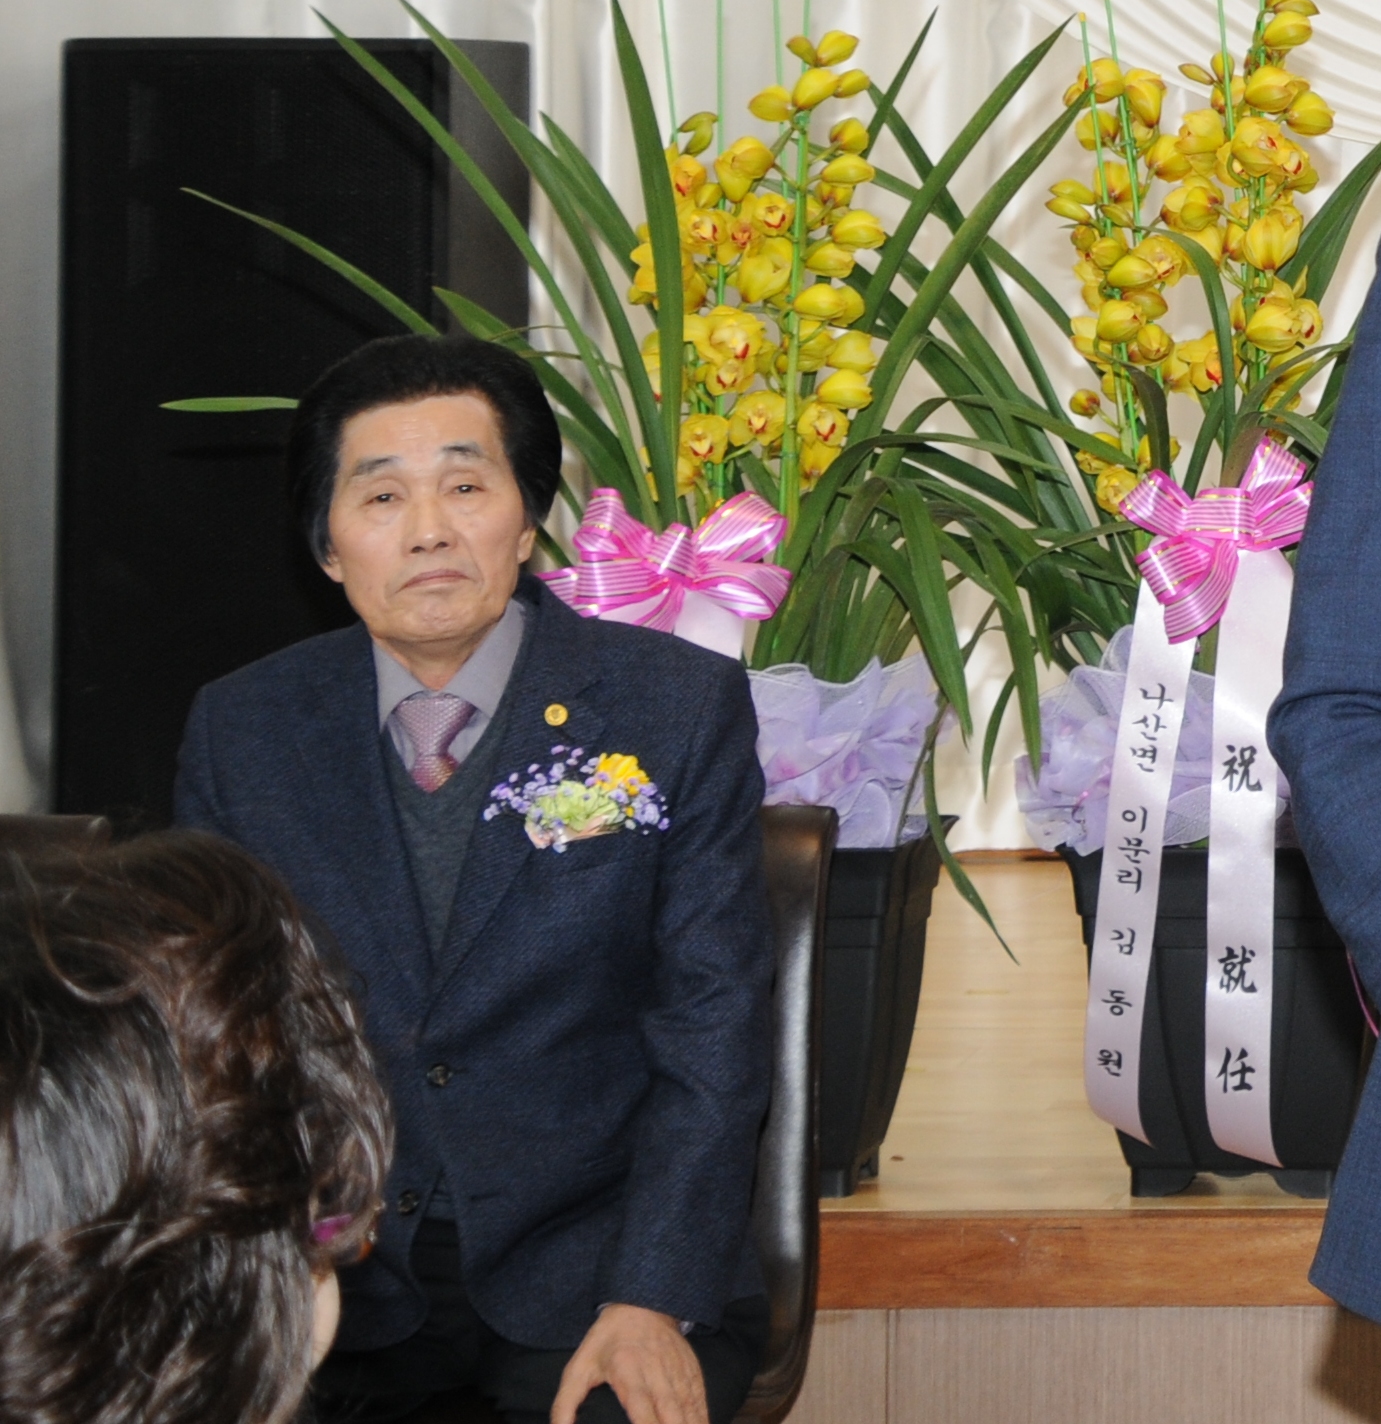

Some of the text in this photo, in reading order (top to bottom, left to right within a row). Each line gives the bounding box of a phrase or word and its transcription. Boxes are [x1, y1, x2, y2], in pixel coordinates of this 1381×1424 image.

[1131, 682, 1174, 775] 나산면
[1223, 744, 1263, 793] 祝
[1116, 805, 1151, 894] 이문리
